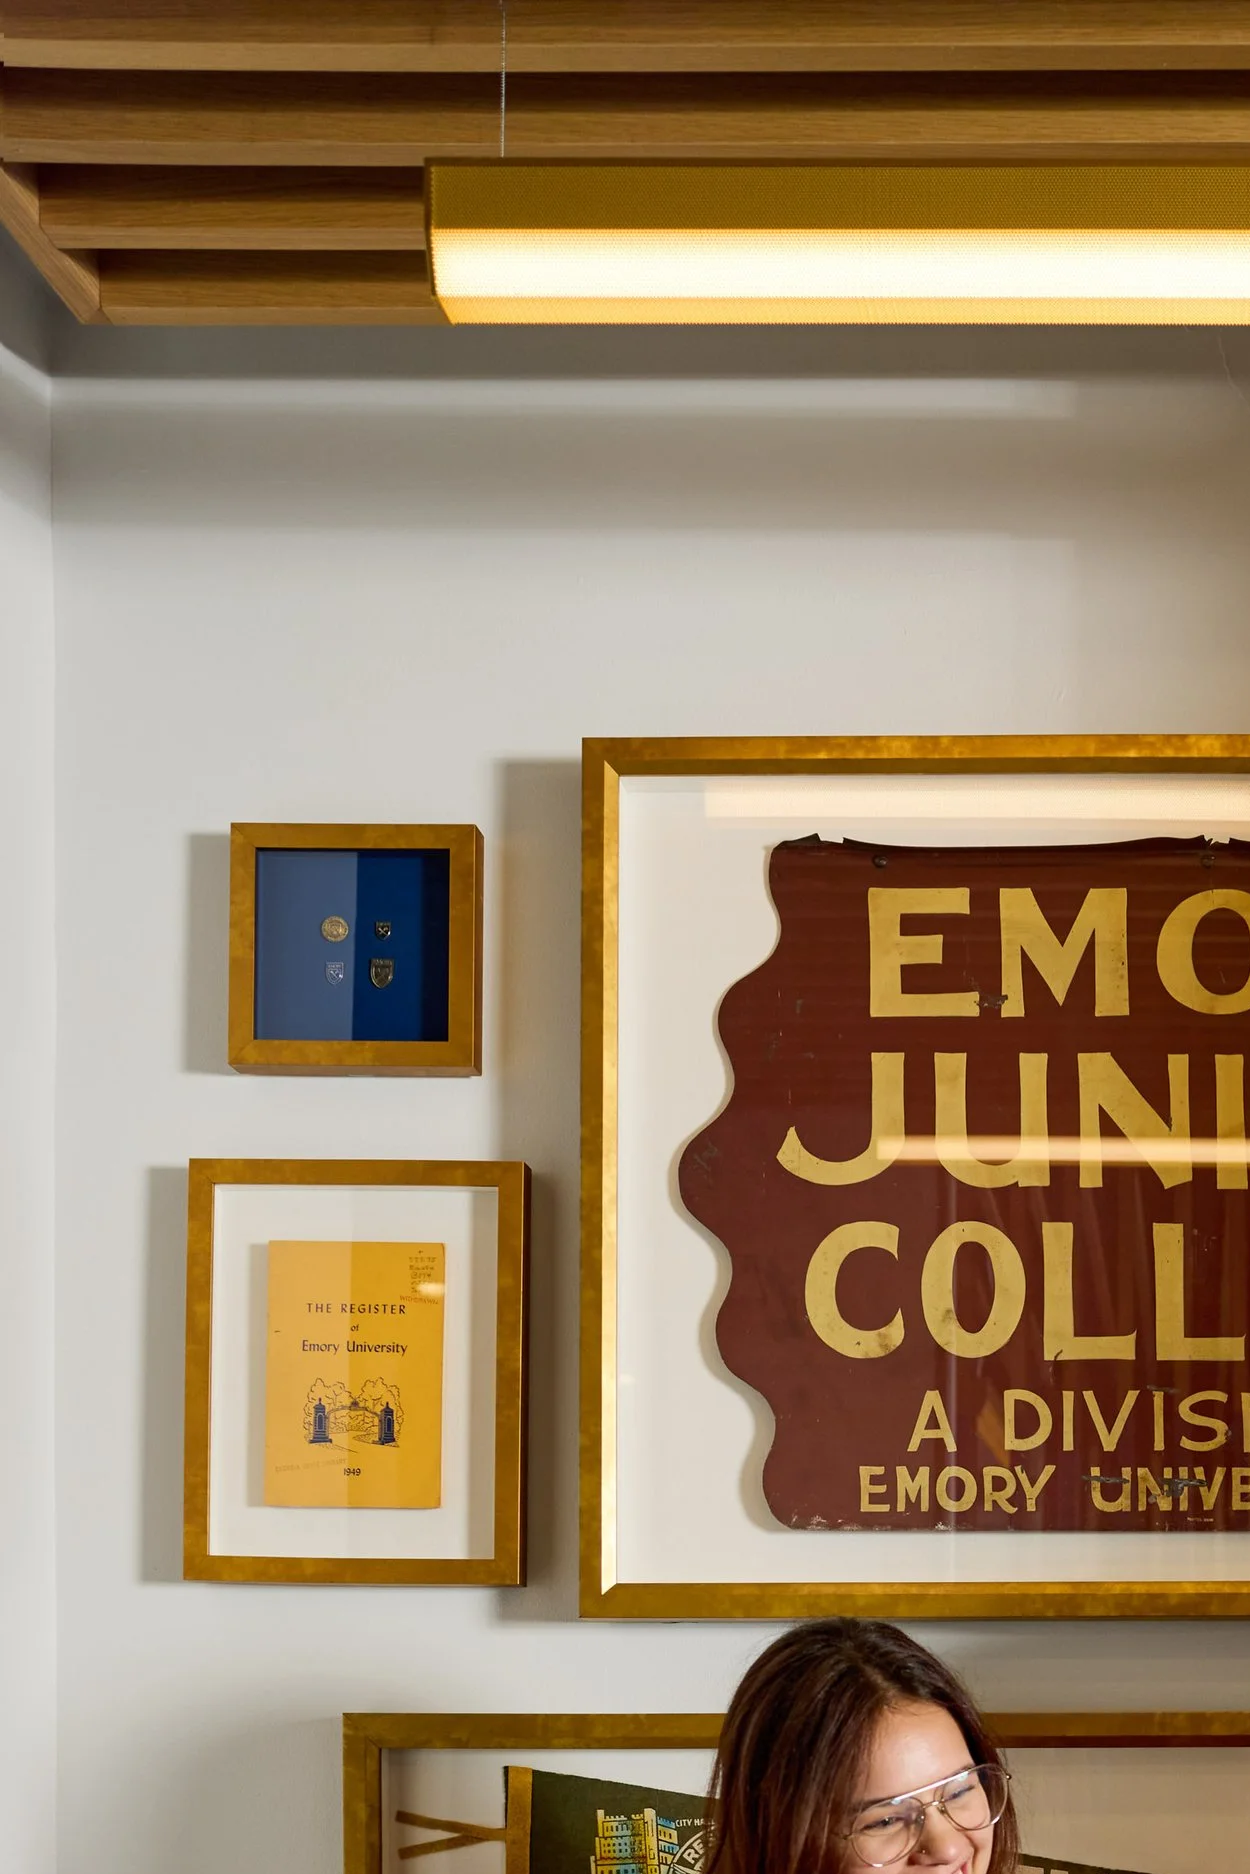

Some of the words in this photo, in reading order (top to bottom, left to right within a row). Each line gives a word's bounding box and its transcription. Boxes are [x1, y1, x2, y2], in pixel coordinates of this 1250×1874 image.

[307, 1303, 332, 1314] THE
[341, 1303, 407, 1315] REGISTER
[350, 1323, 359, 1332] of
[302, 1339, 340, 1356] Emory
[346, 1340, 408, 1356] University
[909, 1391, 957, 1452] A
[343, 1467, 361, 1477] 1949
[860, 1465, 1054, 1515] EMORY
[675, 1819, 692, 1827] CITY
